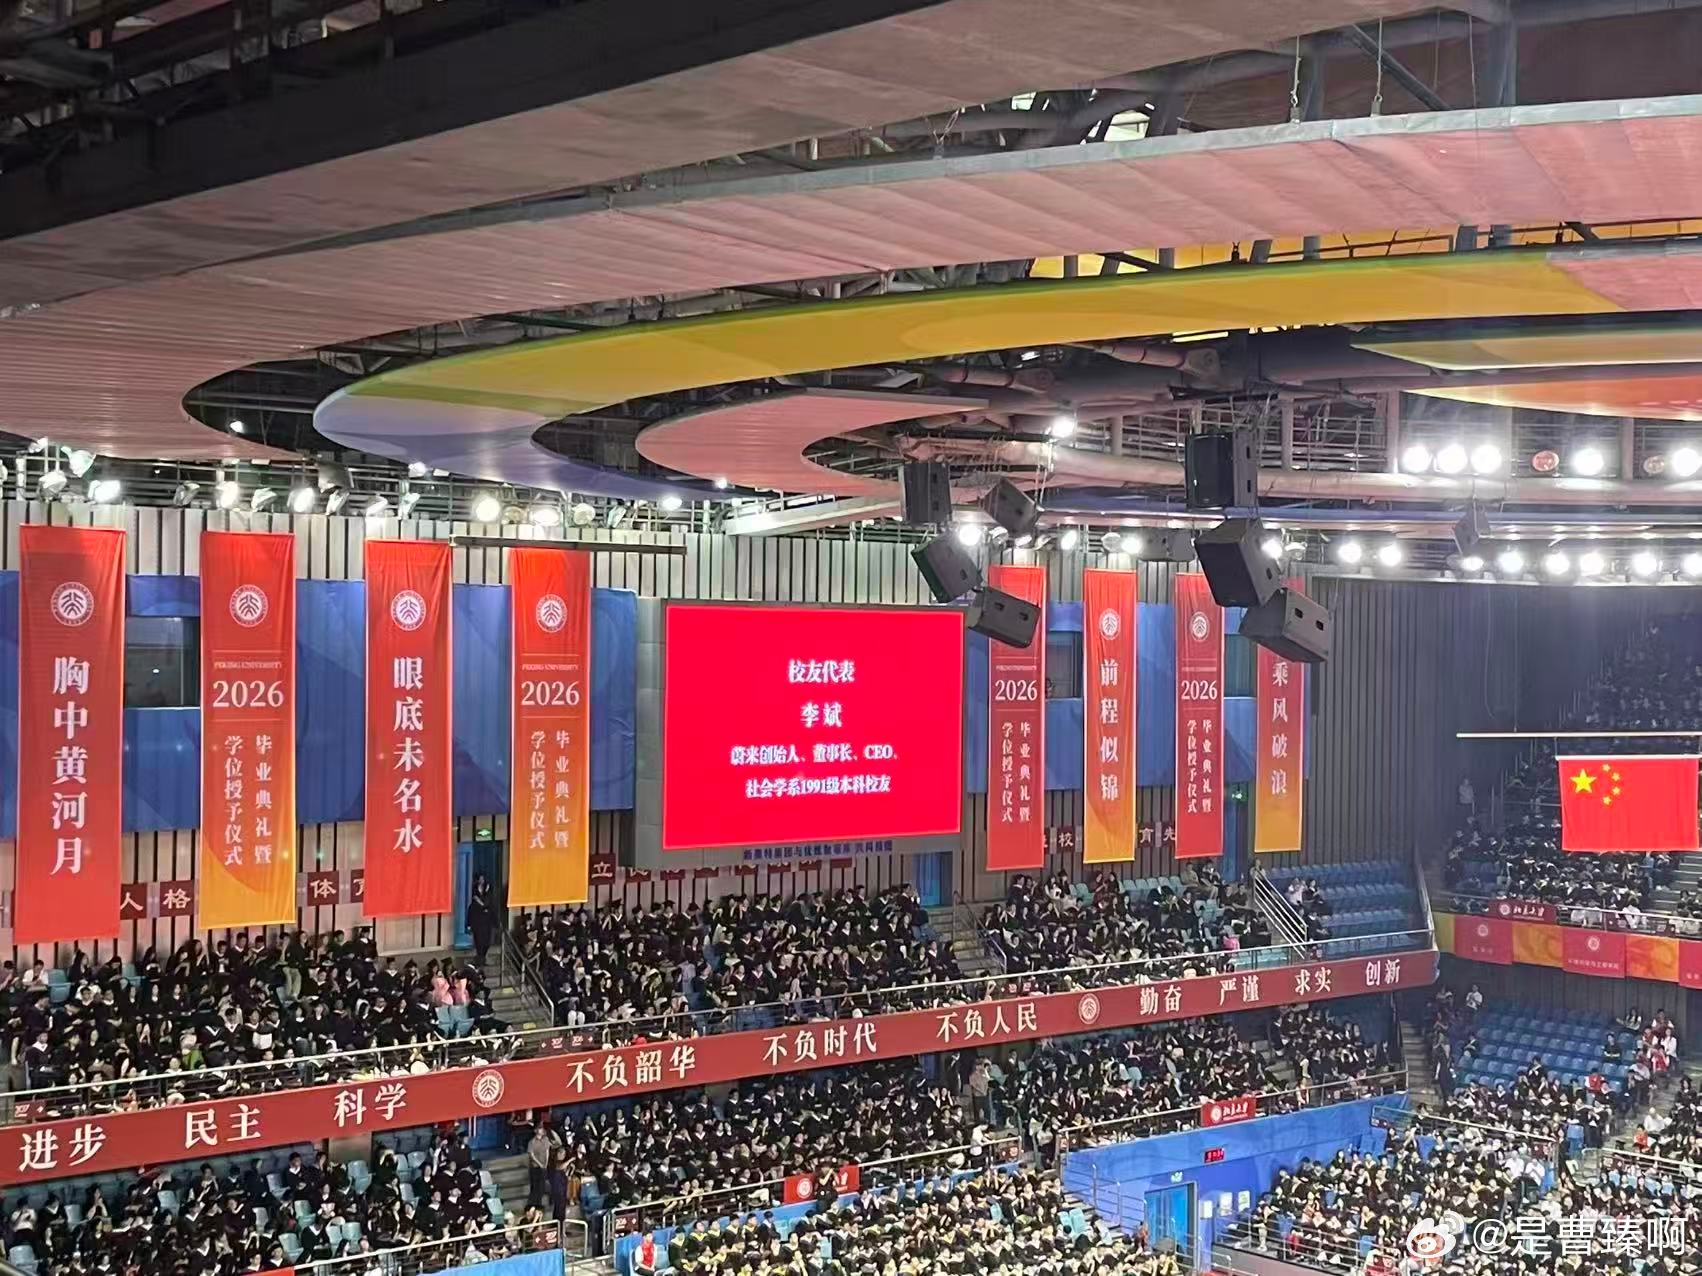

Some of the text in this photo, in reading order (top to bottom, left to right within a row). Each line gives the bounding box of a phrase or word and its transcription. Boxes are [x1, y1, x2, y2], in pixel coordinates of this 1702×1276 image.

[212, 680, 284, 708] 2026
[521, 680, 580, 706] 2026
[788, 659, 855, 683] 校友代表
[801, 702, 842, 728] 李 斌
[995, 679, 1038, 701] 2026
[1181, 679, 1218, 701] 2026
[51, 656, 90, 875] 胸中黄河月
[393, 656, 424, 853] 眼底未名水
[1001, 722, 1013, 823] 学位授予仪式
[1019, 721, 1031, 822] 毕业典礼暨
[1100, 658, 1119, 801] 前程似锦
[1187, 719, 1198, 813] 学位授予仪式
[1202, 719, 1212, 812] 毕业典礼暨
[1271, 661, 1288, 795] 乘风破浪
[223, 735, 243, 866] 学位授予仪式
[254, 734, 273, 864] 毕业典礼暨
[529, 730, 546, 849] 学位授予仪式
[554, 730, 570, 848] 毕业典礼暨
[590, 858, 614, 880] 立
[18, 958, 1401, 1172] 进步 民主 科学 不负韶华 不负时代 不负人民 勤奋 严谨 求实 创新
